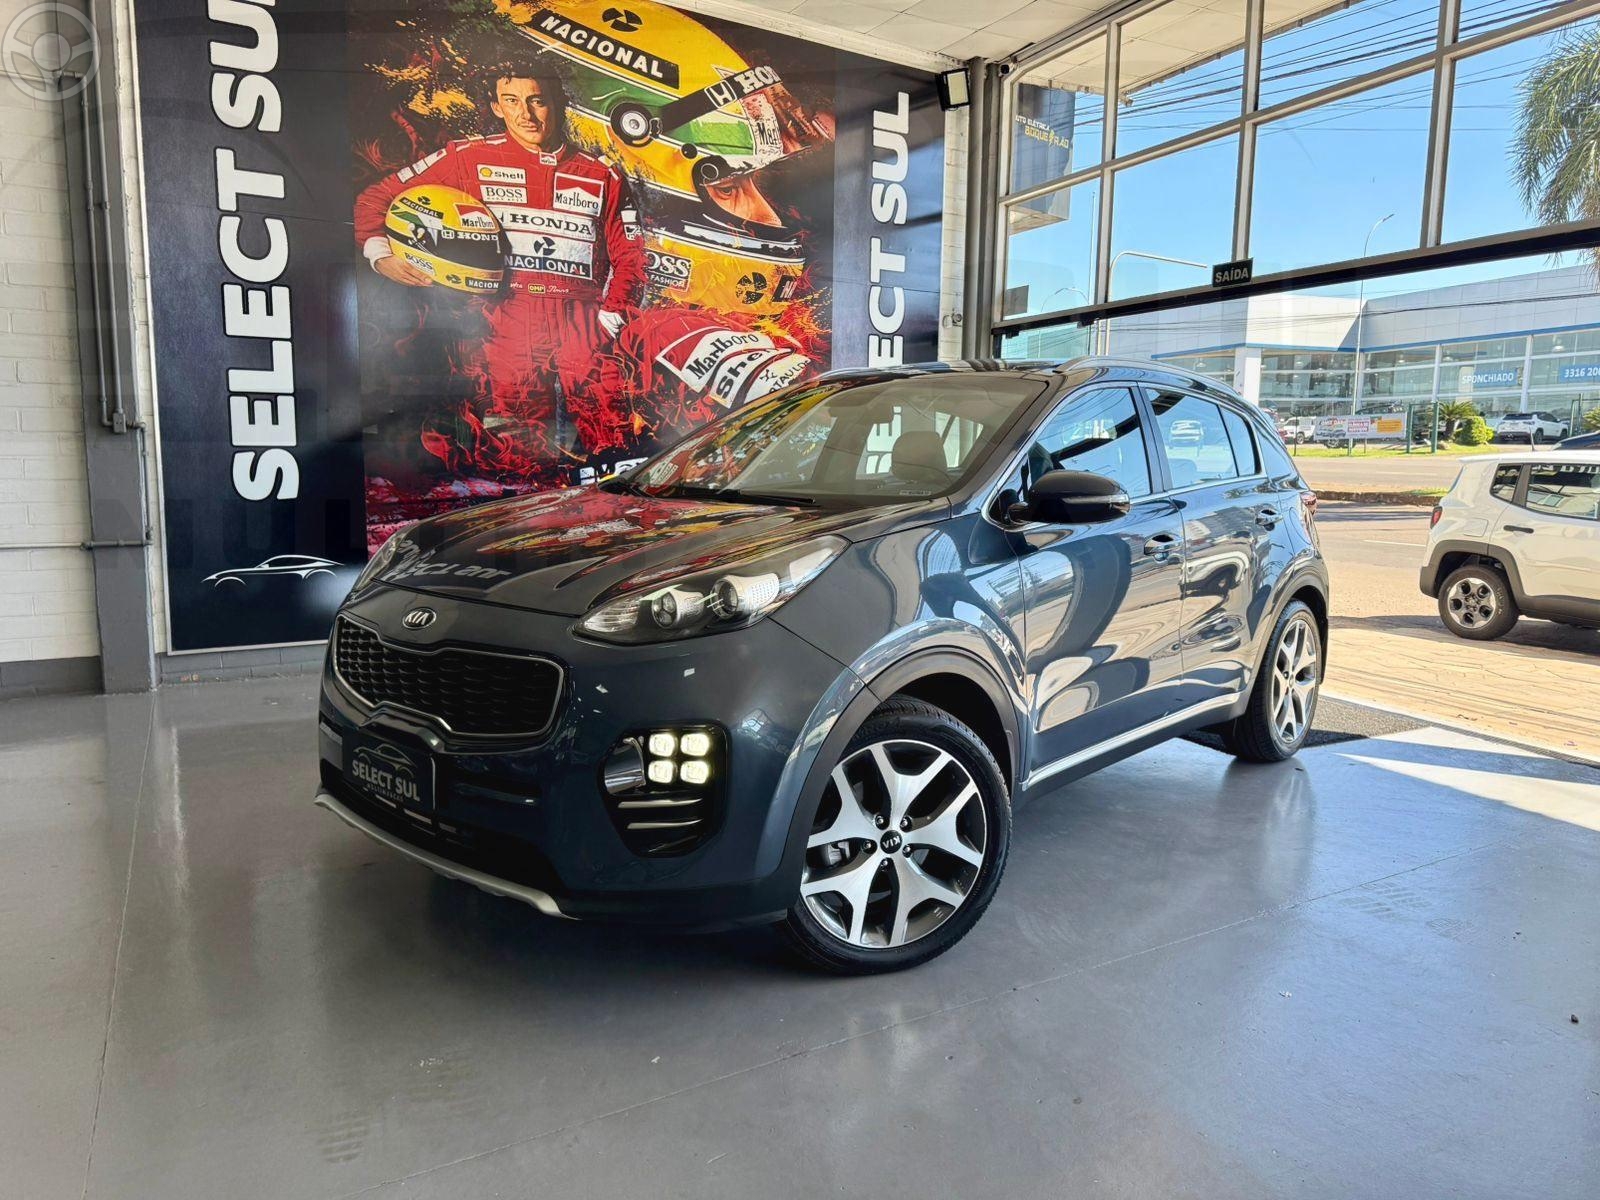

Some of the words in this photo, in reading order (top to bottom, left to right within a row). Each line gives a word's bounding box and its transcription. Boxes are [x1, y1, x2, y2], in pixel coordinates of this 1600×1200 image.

[540, 15, 664, 79] NACIONAL
[207, 0, 282, 132] SU
[869, 91, 910, 225] SUL
[494, 171, 524, 180] Shell
[485, 186, 523, 199] BOSS
[555, 190, 599, 210] Marlboro
[402, 198, 439, 218] NACIONAL
[509, 212, 594, 236] HONDA
[404, 252, 434, 271] BOSS
[645, 251, 690, 278] OSS
[468, 279, 500, 289] NACION
[1215, 267, 1250, 284] SAÍDA
[215, 147, 300, 501] SELECT
[686, 333, 760, 381] Marlboro
[715, 349, 770, 400] She
[1462, 372, 1515, 385] SPONCHIADO
[1564, 368, 1586, 378] 3316
[404, 610, 430, 626] KIA
[352, 760, 393, 790] SELECT
[395, 776, 421, 802] SUL
[882, 835, 901, 849] KIA
